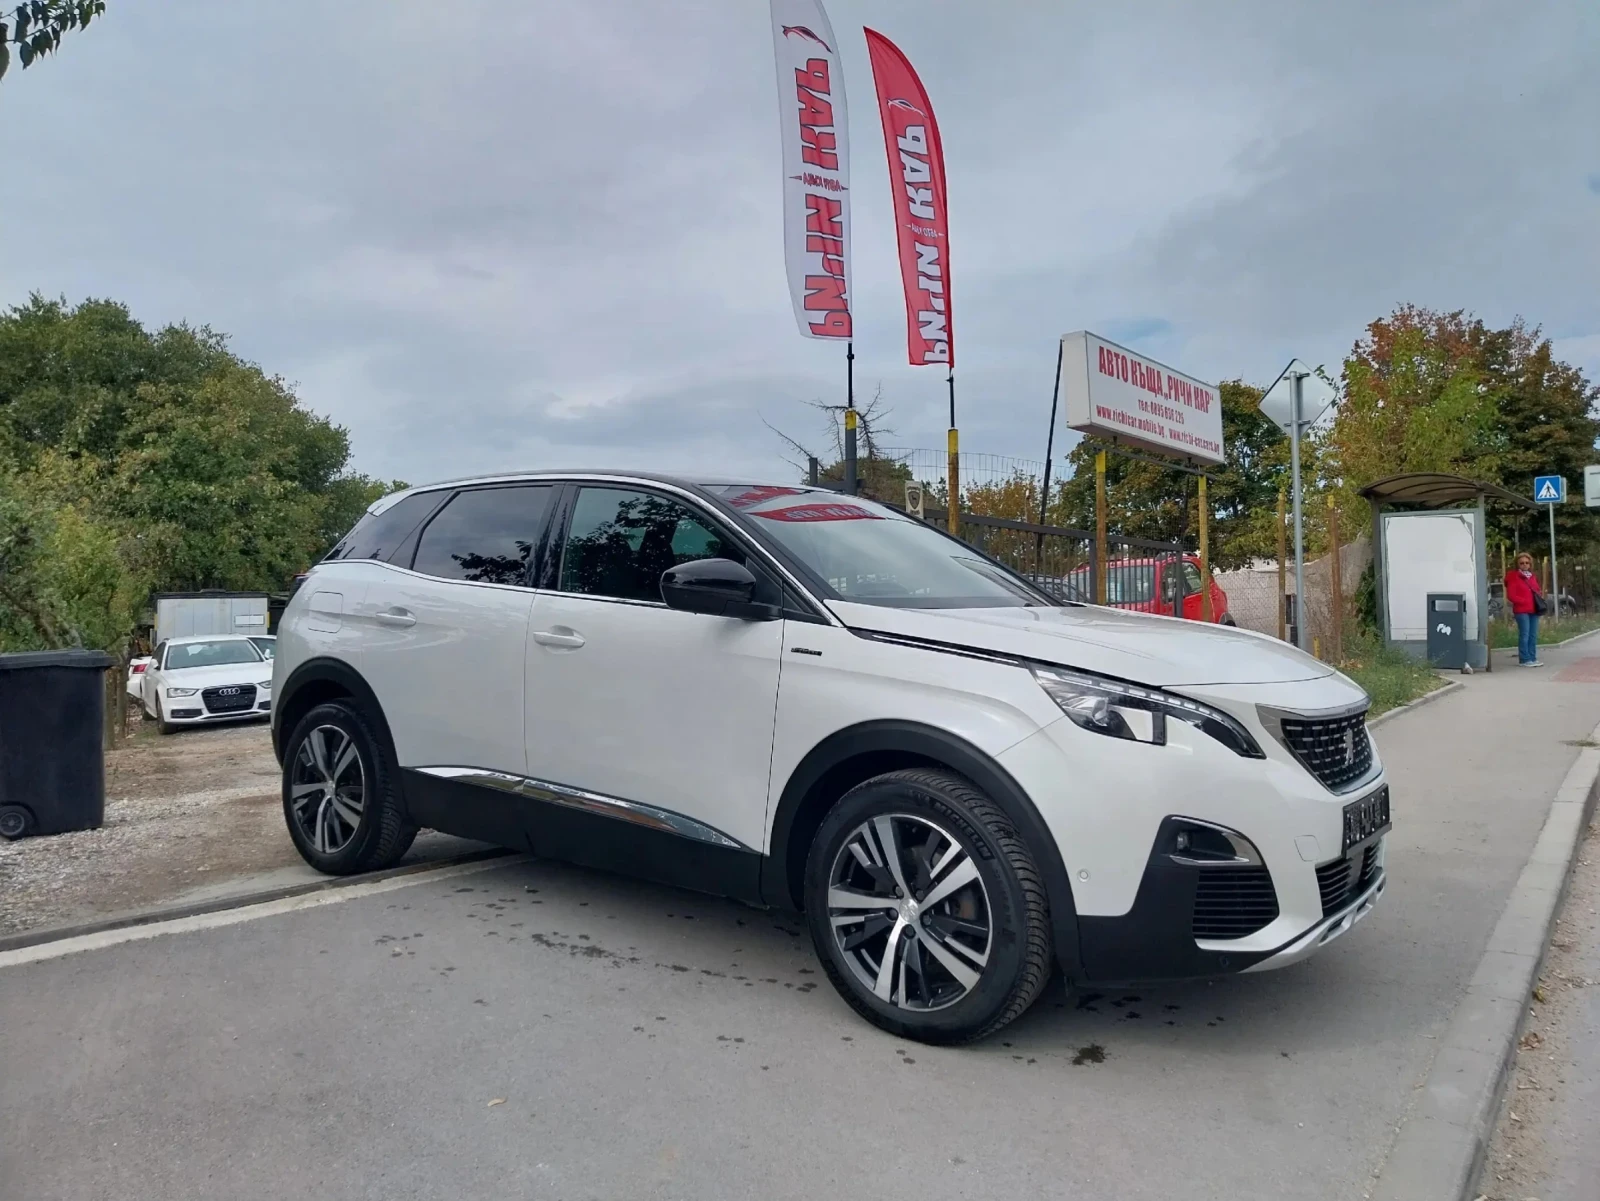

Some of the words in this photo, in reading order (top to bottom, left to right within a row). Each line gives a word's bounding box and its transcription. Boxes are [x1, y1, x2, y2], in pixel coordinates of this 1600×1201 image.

[1098, 345, 1129, 383] АВТО
[1130, 358, 1163, 398] КЪЩА
[932, 800, 995, 861] MICHELIN
